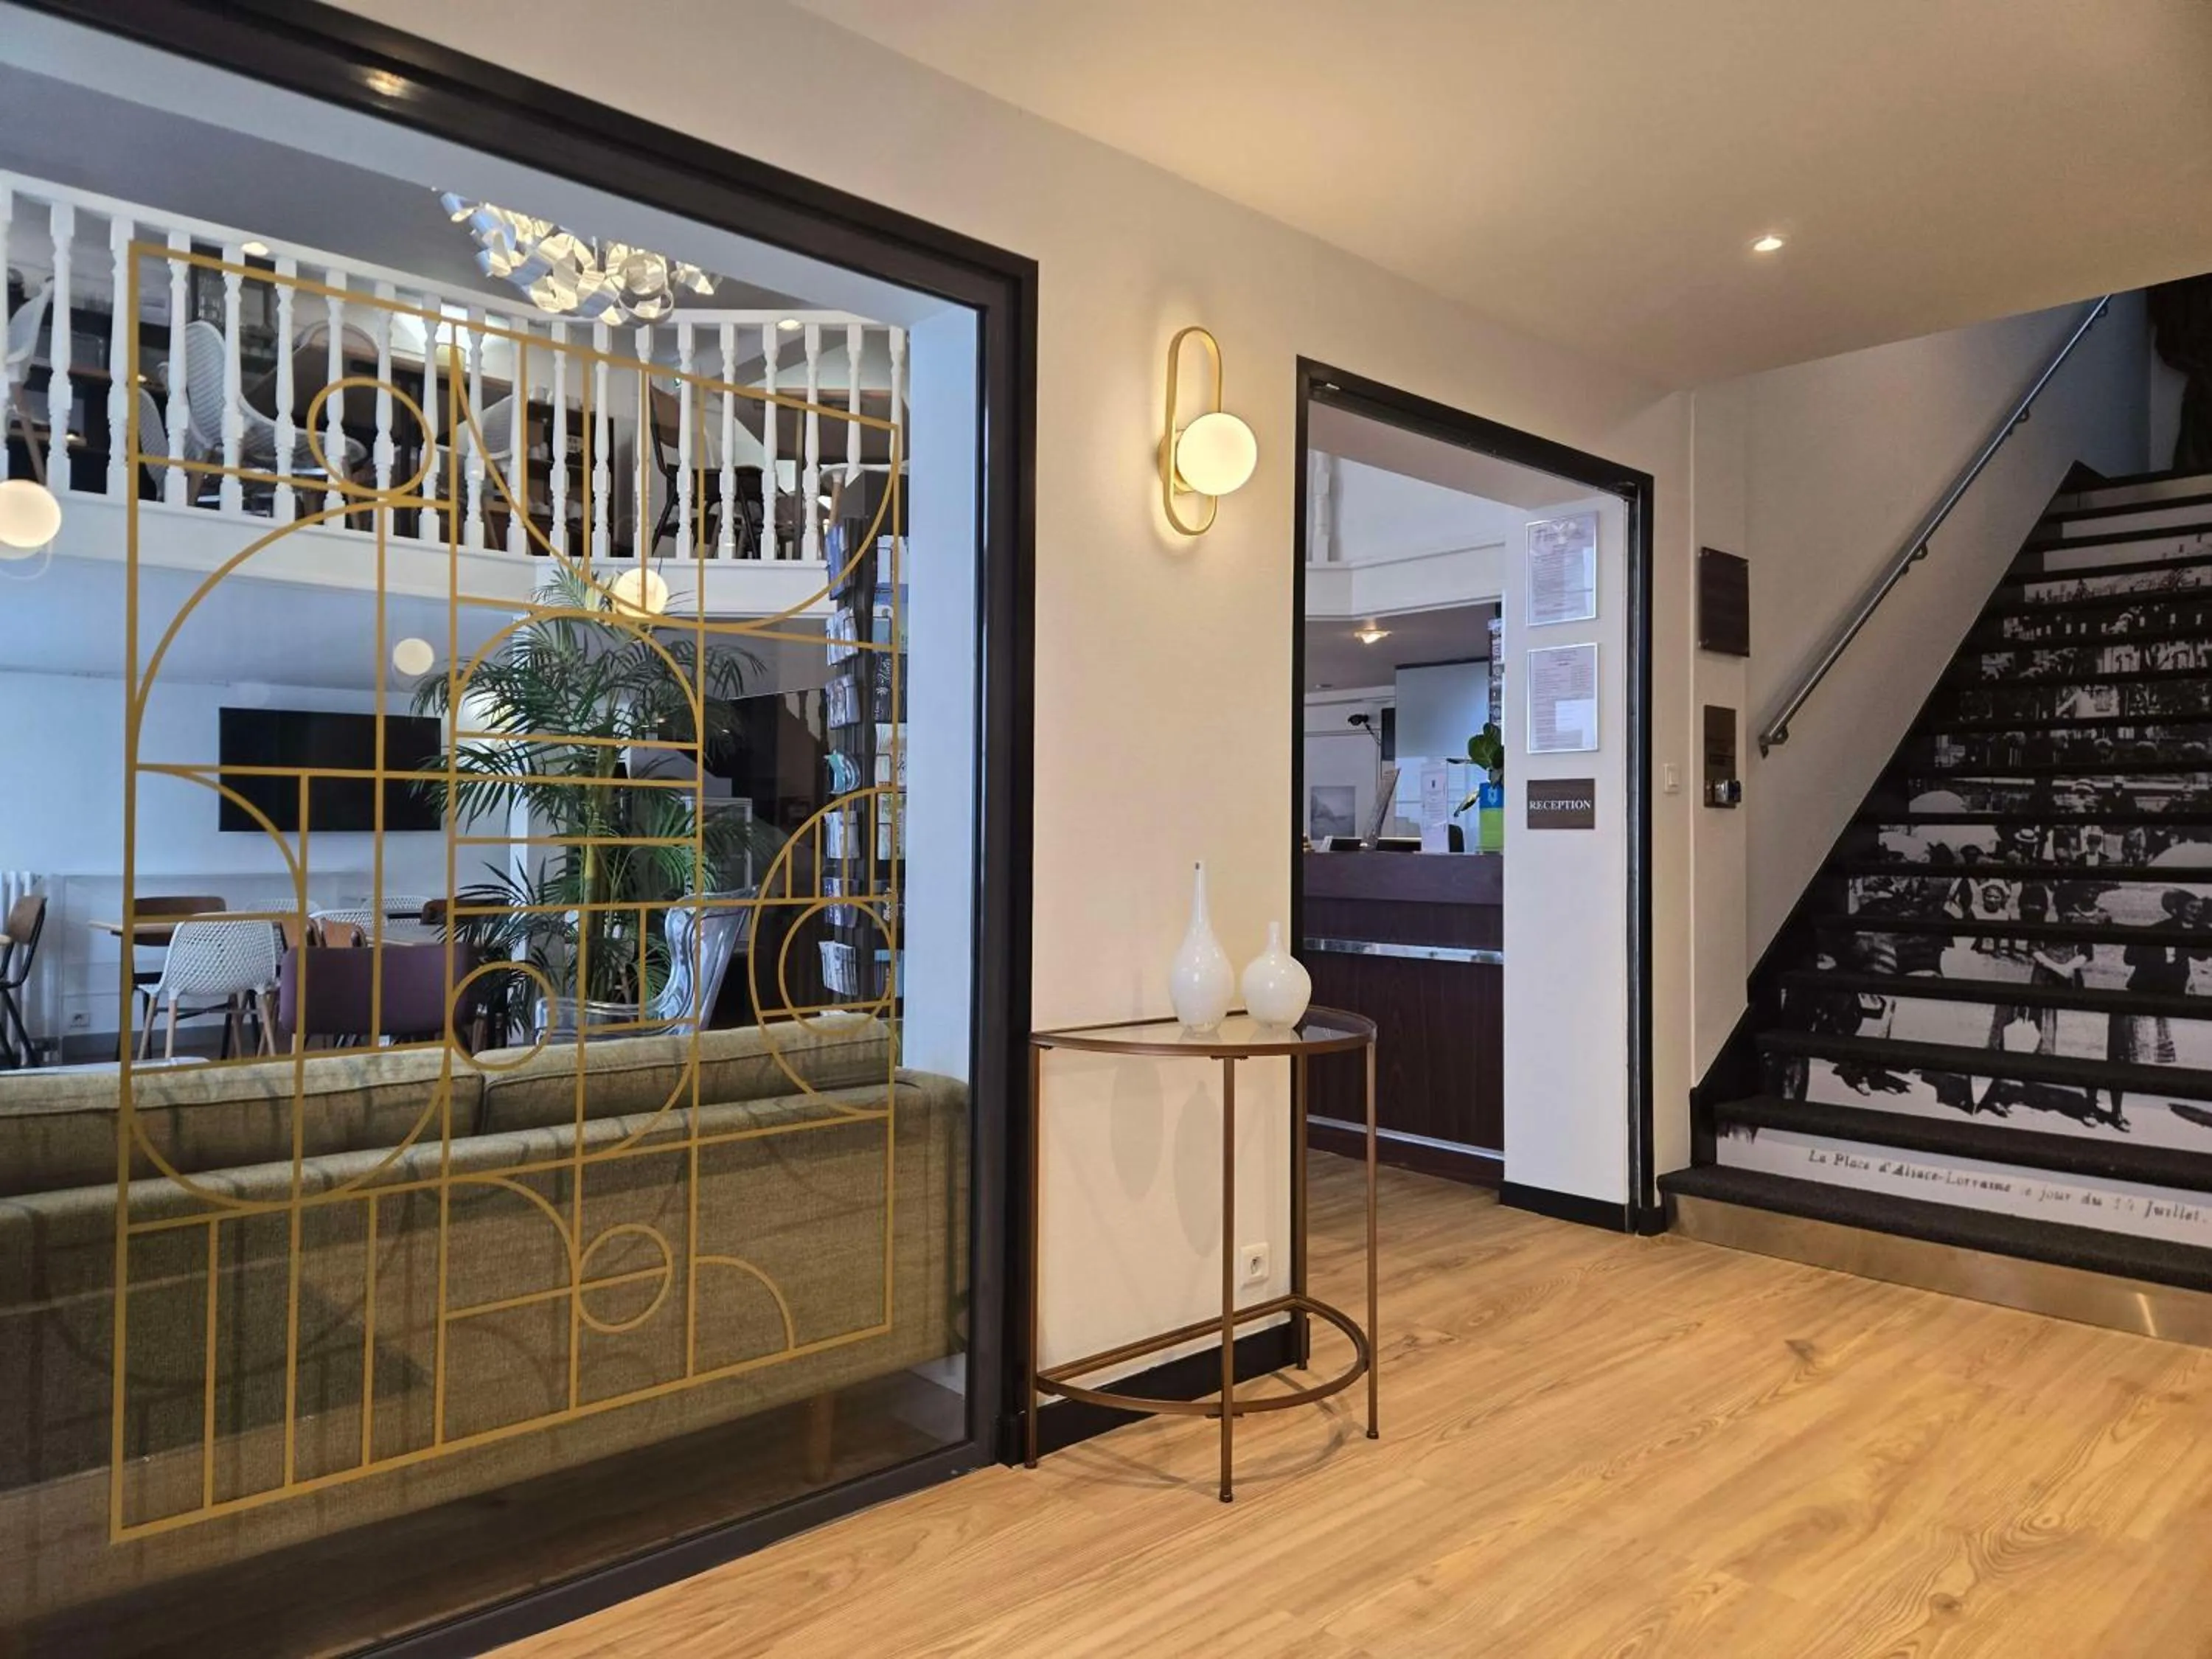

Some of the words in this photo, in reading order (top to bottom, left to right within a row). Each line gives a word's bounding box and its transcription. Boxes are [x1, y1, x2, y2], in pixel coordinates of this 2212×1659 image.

[1528, 799, 1592, 810] RECEPTION
[1809, 1150, 1826, 1164] La
[1834, 1153, 1870, 1170] Place
[2038, 1185, 2072, 1203] jour
[2081, 1192, 2102, 1206] du
